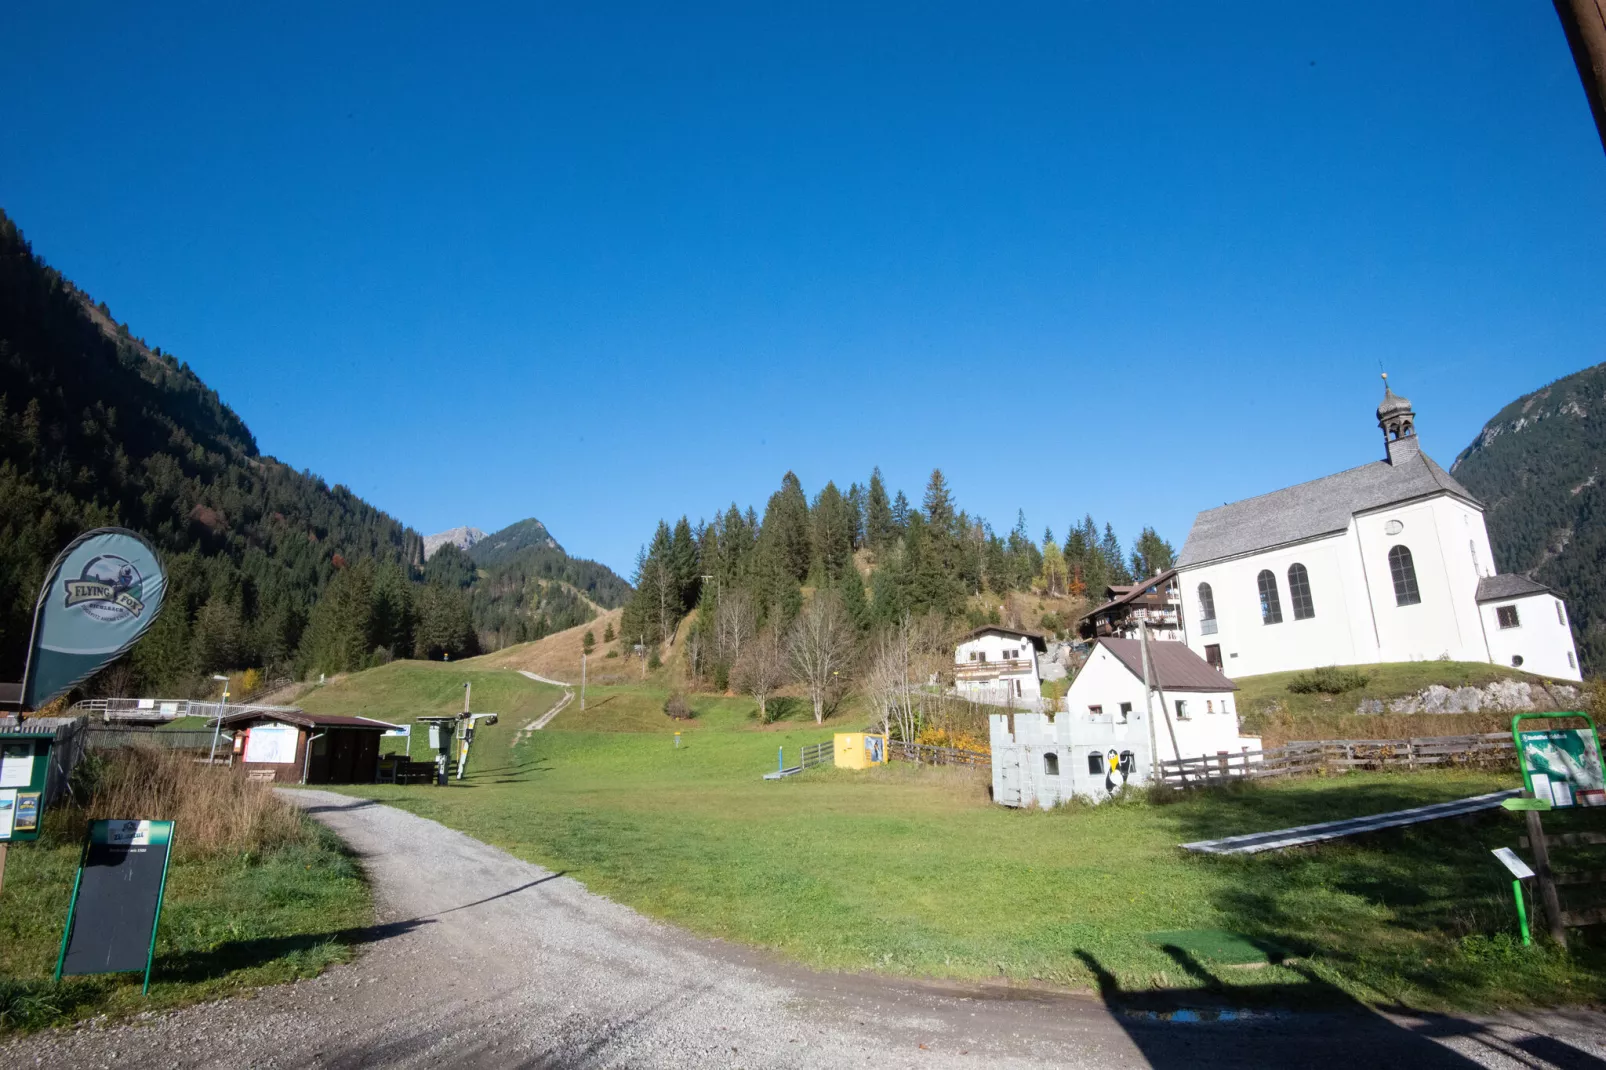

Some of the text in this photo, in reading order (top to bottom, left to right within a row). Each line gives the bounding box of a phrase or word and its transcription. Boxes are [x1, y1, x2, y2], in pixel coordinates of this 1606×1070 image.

[75, 585, 139, 610] FLYING FOX
[113, 832, 144, 840] Zilrtal
